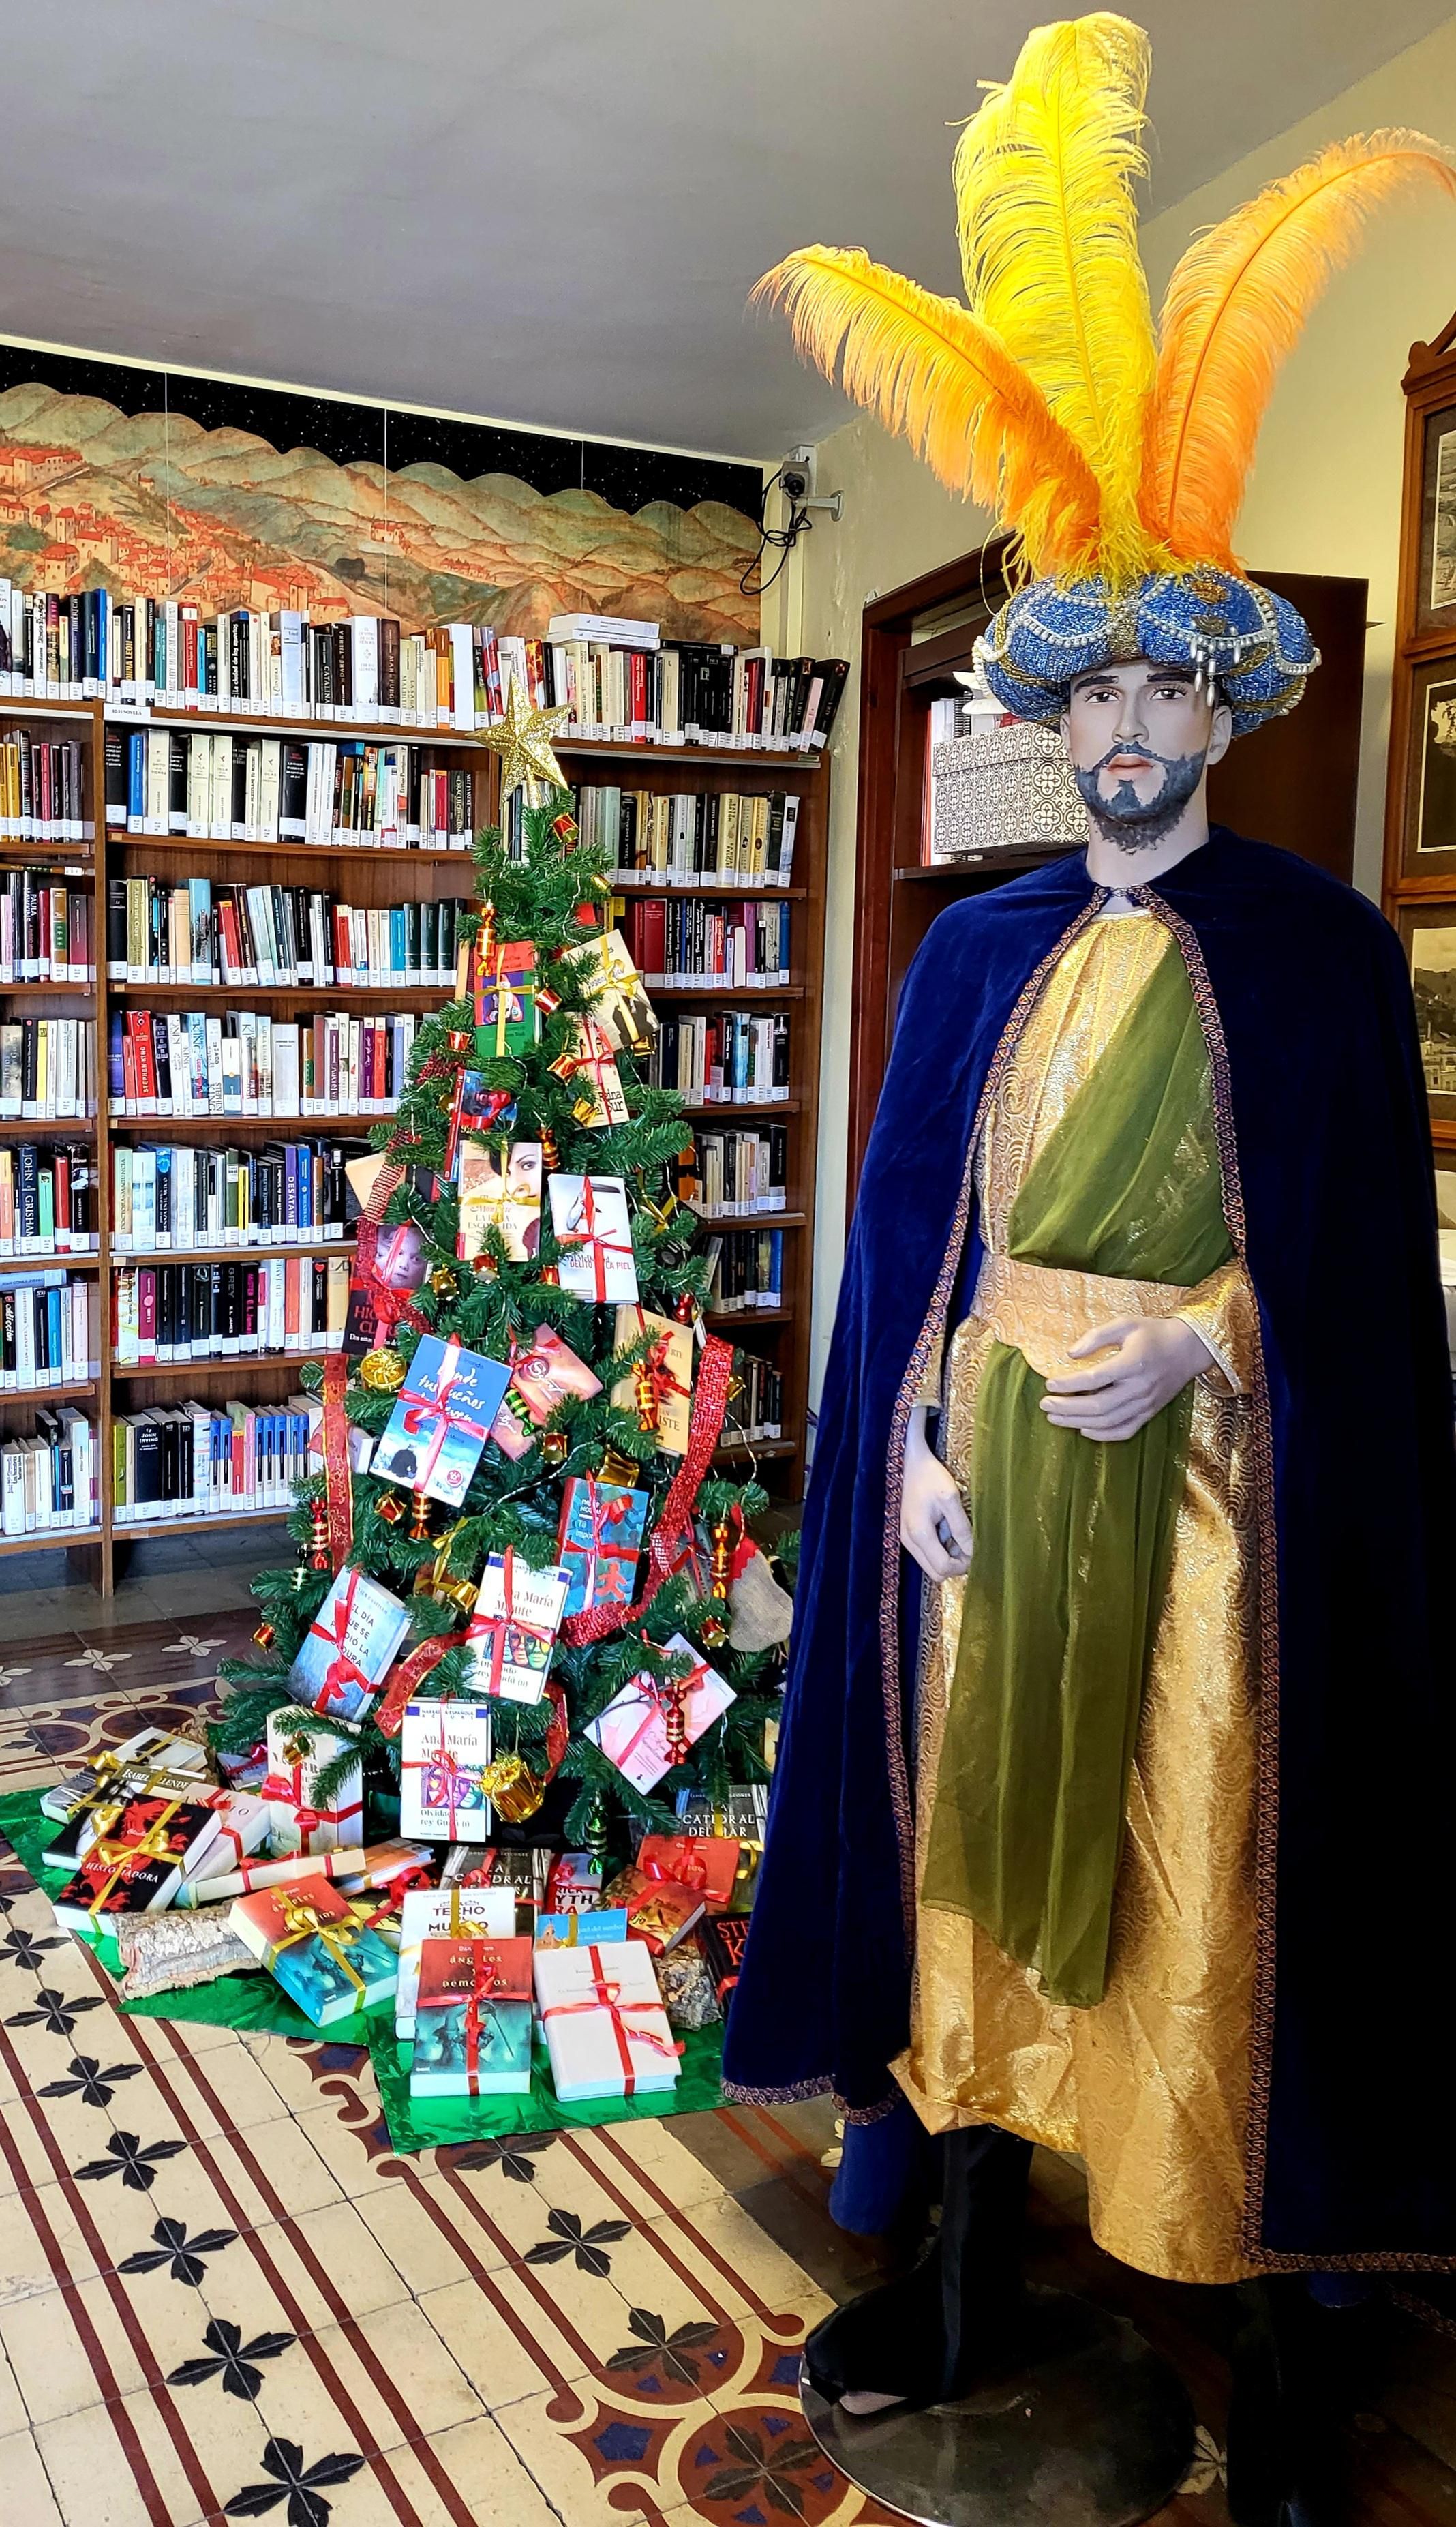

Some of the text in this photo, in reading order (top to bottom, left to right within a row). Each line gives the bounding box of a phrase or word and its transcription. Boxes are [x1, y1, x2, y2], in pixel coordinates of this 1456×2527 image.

[125, 661, 134, 681] ONNA
[323, 666, 331, 704] CATALINA
[24, 1154, 33, 1181] JOHN
[288, 1176, 296, 1223] DESÁTAME
[569, 1260, 593, 1269] DELITO
[616, 1261, 632, 1270] PIEL
[448, 1389, 486, 1411] ueños
[523, 1590, 554, 1608] María
[360, 1611, 375, 1628] DÍA
[359, 1628, 371, 1641] SE
[359, 1644, 369, 1658] LA
[447, 1733, 479, 1747] María
[121, 1768, 189, 1789] ISABEL LLENDE
[420, 1819, 435, 1828] rey
[688, 1827, 711, 1838] DEL
[85, 1861, 159, 1883] HISTOIADORA
[428, 1921, 489, 1932] MUO
